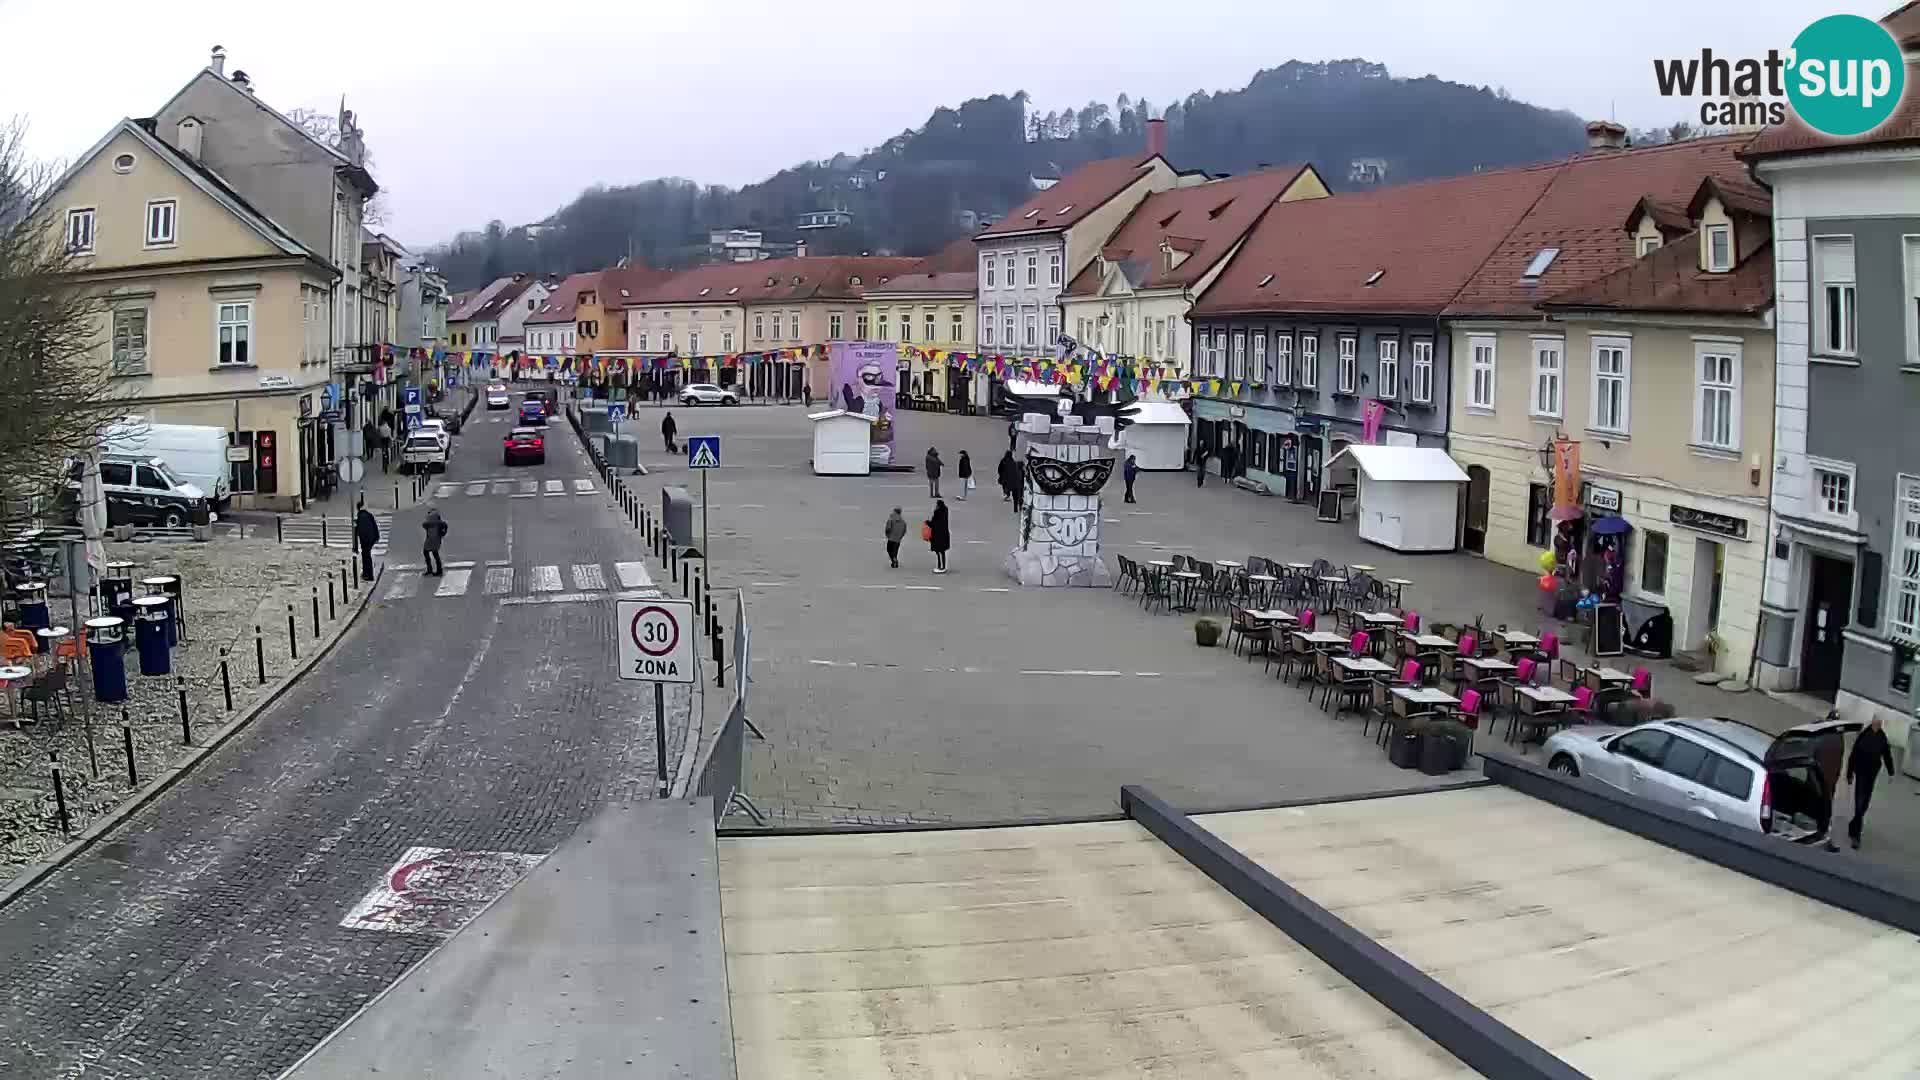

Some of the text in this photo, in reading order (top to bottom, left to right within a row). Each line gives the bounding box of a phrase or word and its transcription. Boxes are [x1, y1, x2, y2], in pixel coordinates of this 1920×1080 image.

[408, 391, 416, 402] P
[1048, 516, 1087, 546] 200
[643, 622, 668, 643] 30
[634, 659, 679, 676] ZONA
